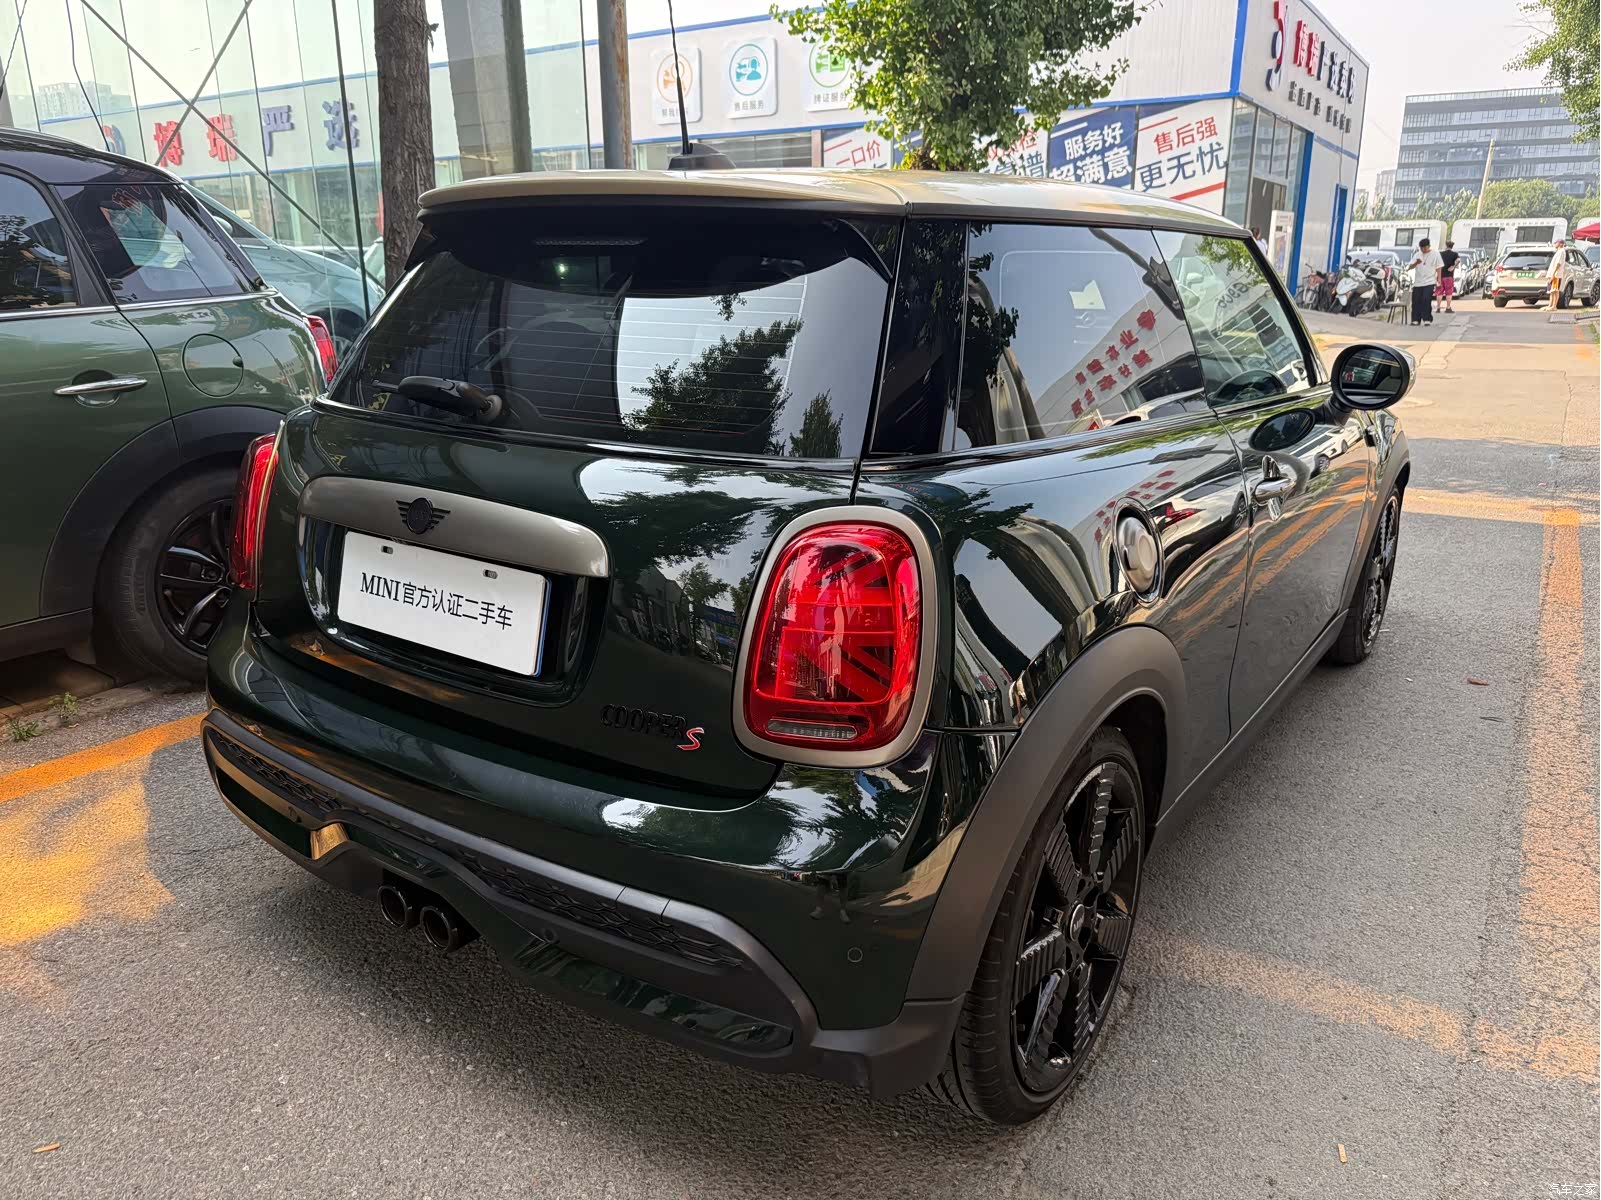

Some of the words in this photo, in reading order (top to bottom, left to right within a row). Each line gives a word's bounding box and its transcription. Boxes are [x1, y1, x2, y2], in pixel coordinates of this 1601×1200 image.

[733, 99, 765, 112] 售后服务
[836, 139, 881, 166] 一口价
[1063, 121, 1124, 161] 服务好
[1153, 116, 1218, 155] 售后强
[1137, 141, 1227, 192] 更无忧
[601, 703, 686, 739] COOPER
[677, 727, 705, 750] S
